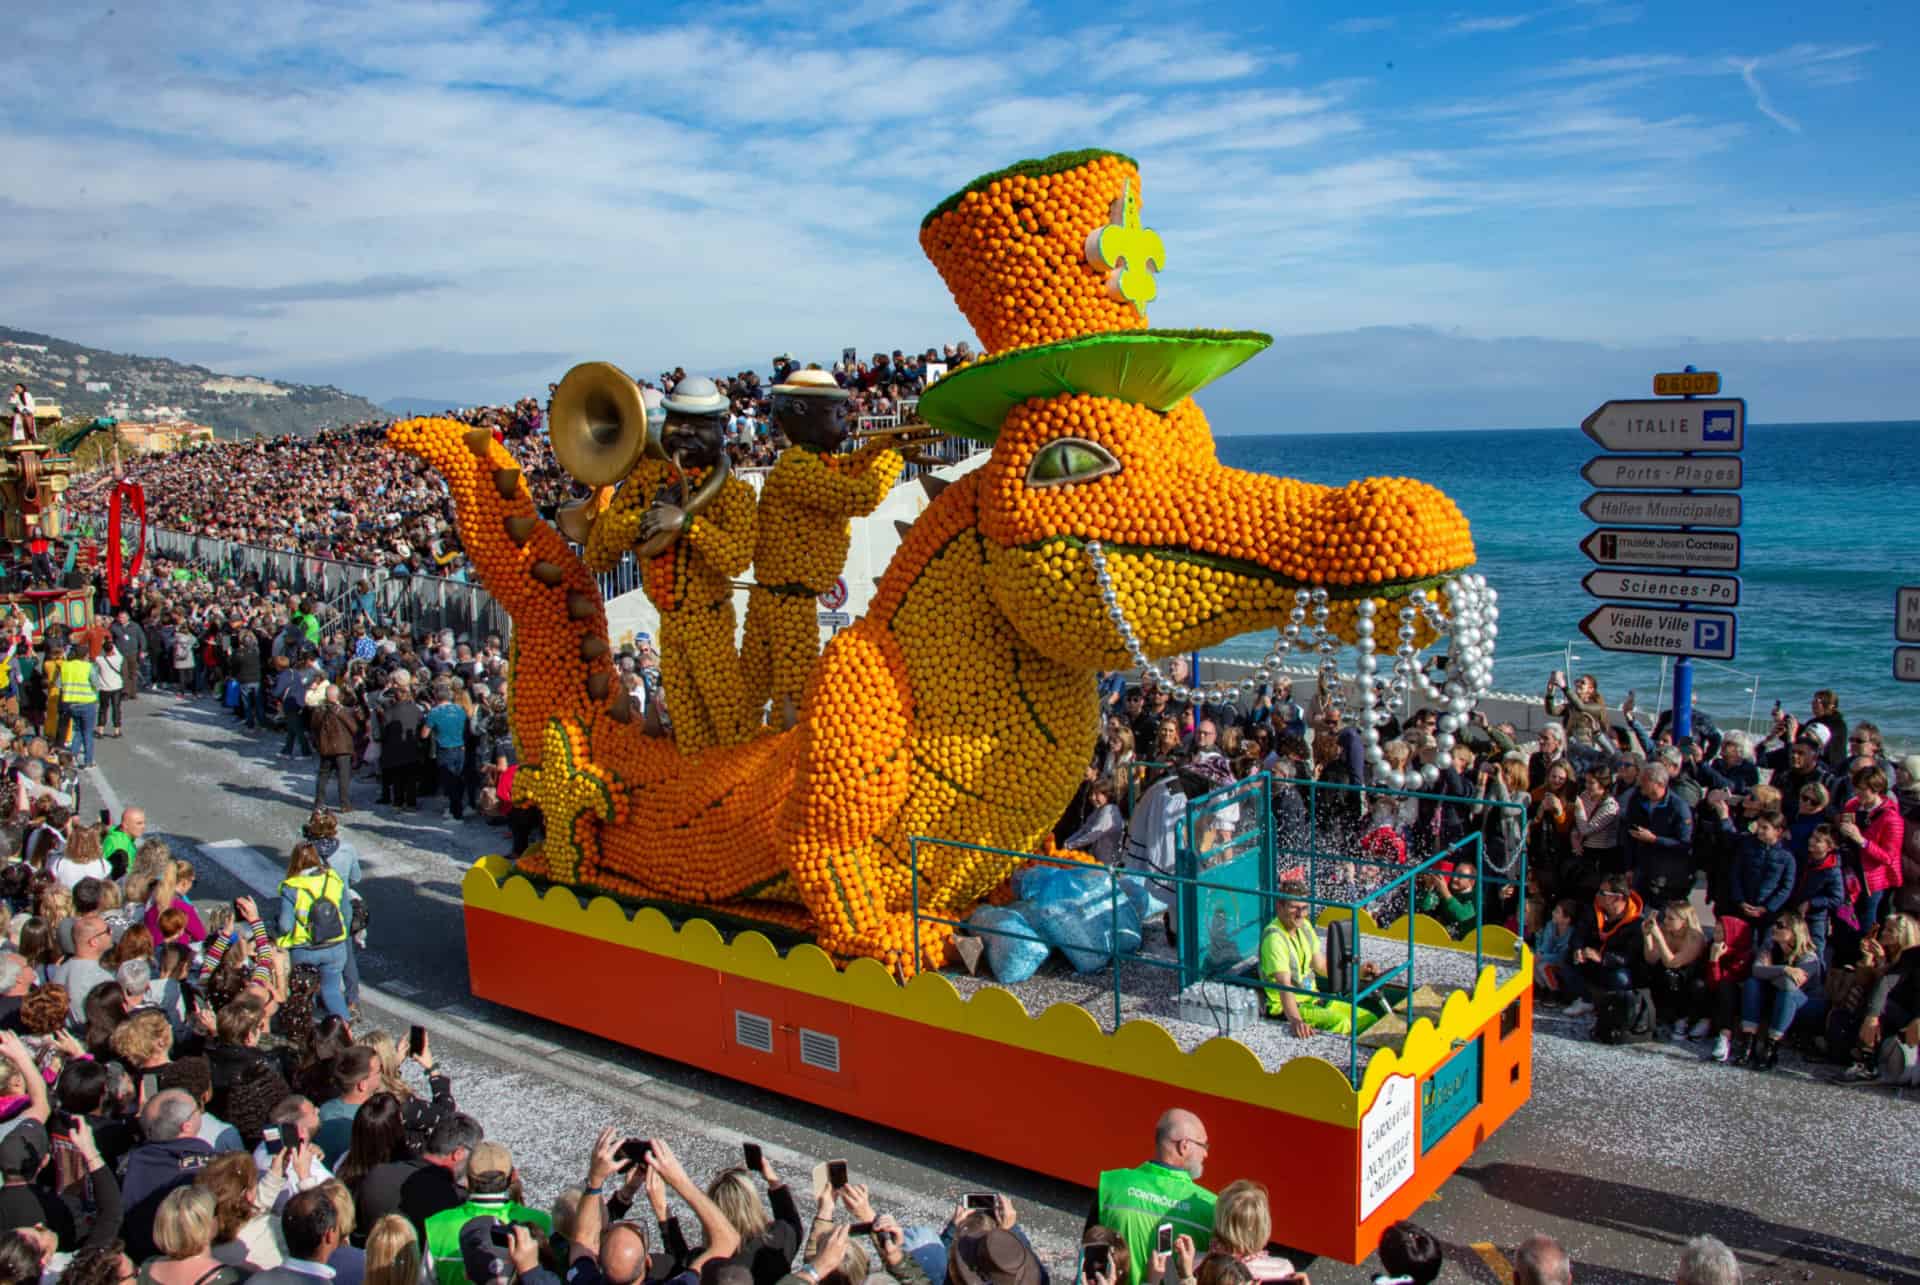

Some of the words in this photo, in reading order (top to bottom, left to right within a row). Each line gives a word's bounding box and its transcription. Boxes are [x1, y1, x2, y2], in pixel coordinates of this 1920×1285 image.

[1627, 418, 1689, 433] ITALIE
[1616, 466, 1660, 480] Ports
[1675, 466, 1735, 483] Plages
[1601, 502, 1643, 515] Halles
[1647, 503, 1733, 520] Municipales
[1686, 538, 1734, 551] Cocteau
[1610, 613, 1653, 629] Vieille
[1658, 616, 1689, 632] Ville
